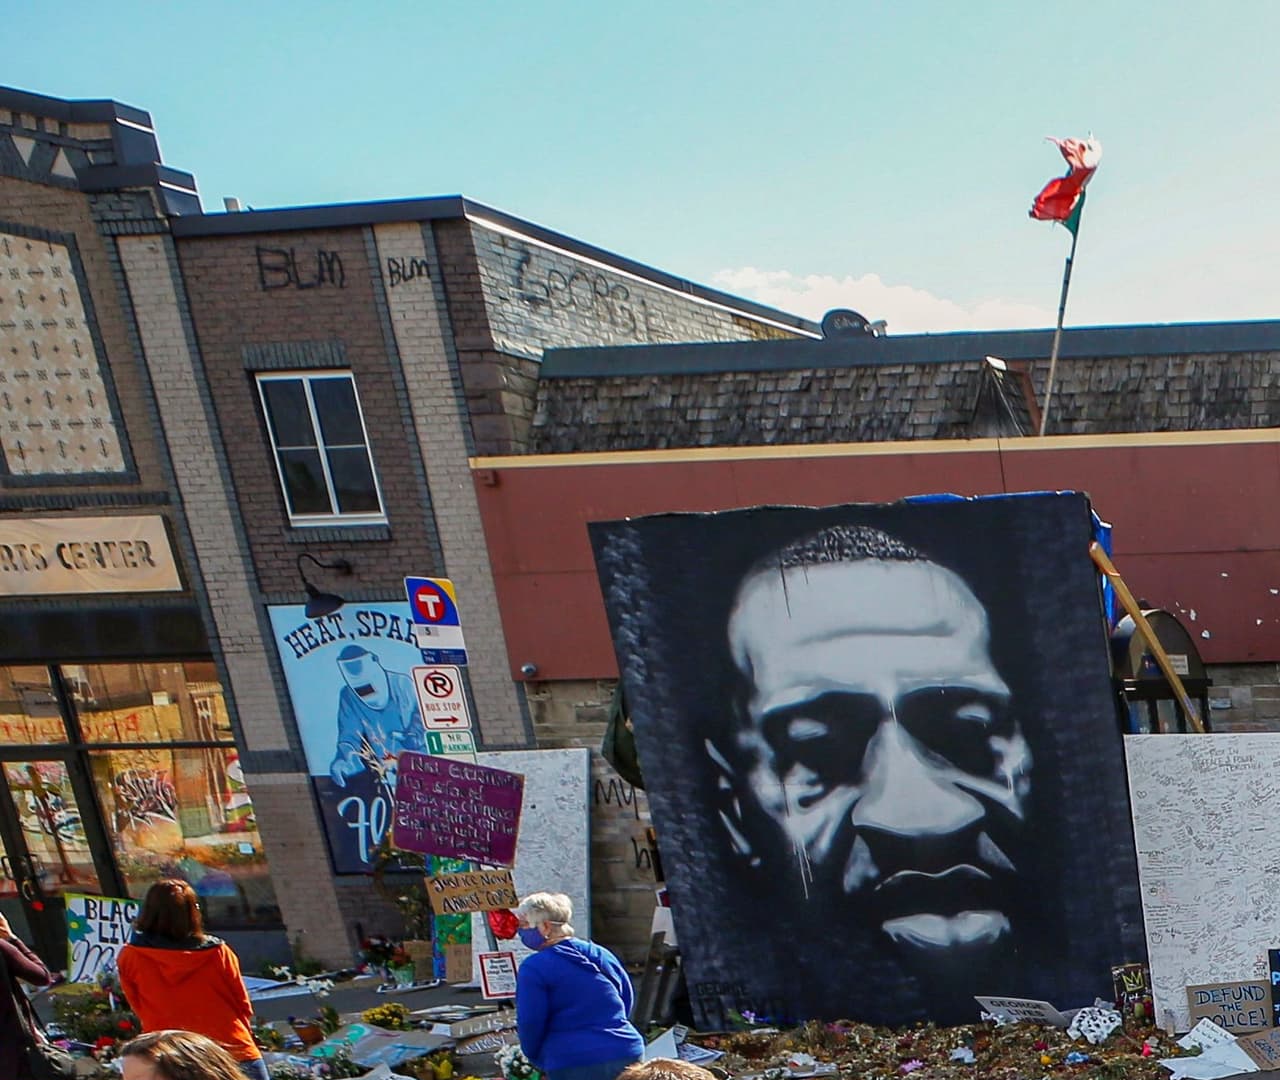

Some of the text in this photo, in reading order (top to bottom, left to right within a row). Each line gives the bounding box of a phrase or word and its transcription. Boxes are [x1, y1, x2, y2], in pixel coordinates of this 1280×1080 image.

[256, 246, 345, 292] BLM
[387, 257, 430, 287] BLM
[0, 540, 156, 571] RTS CENTER
[417, 594, 441, 618] T
[283, 612, 356, 659] HEAT,
[426, 703, 462, 713] BUS STOP
[85, 898, 136, 922] BLAC
[99, 921, 132, 944] LIV
[1195, 985, 1266, 1005] DEFUND
[1220, 1002, 1242, 1012] THE
[1008, 1007, 1046, 1018] LIVES
